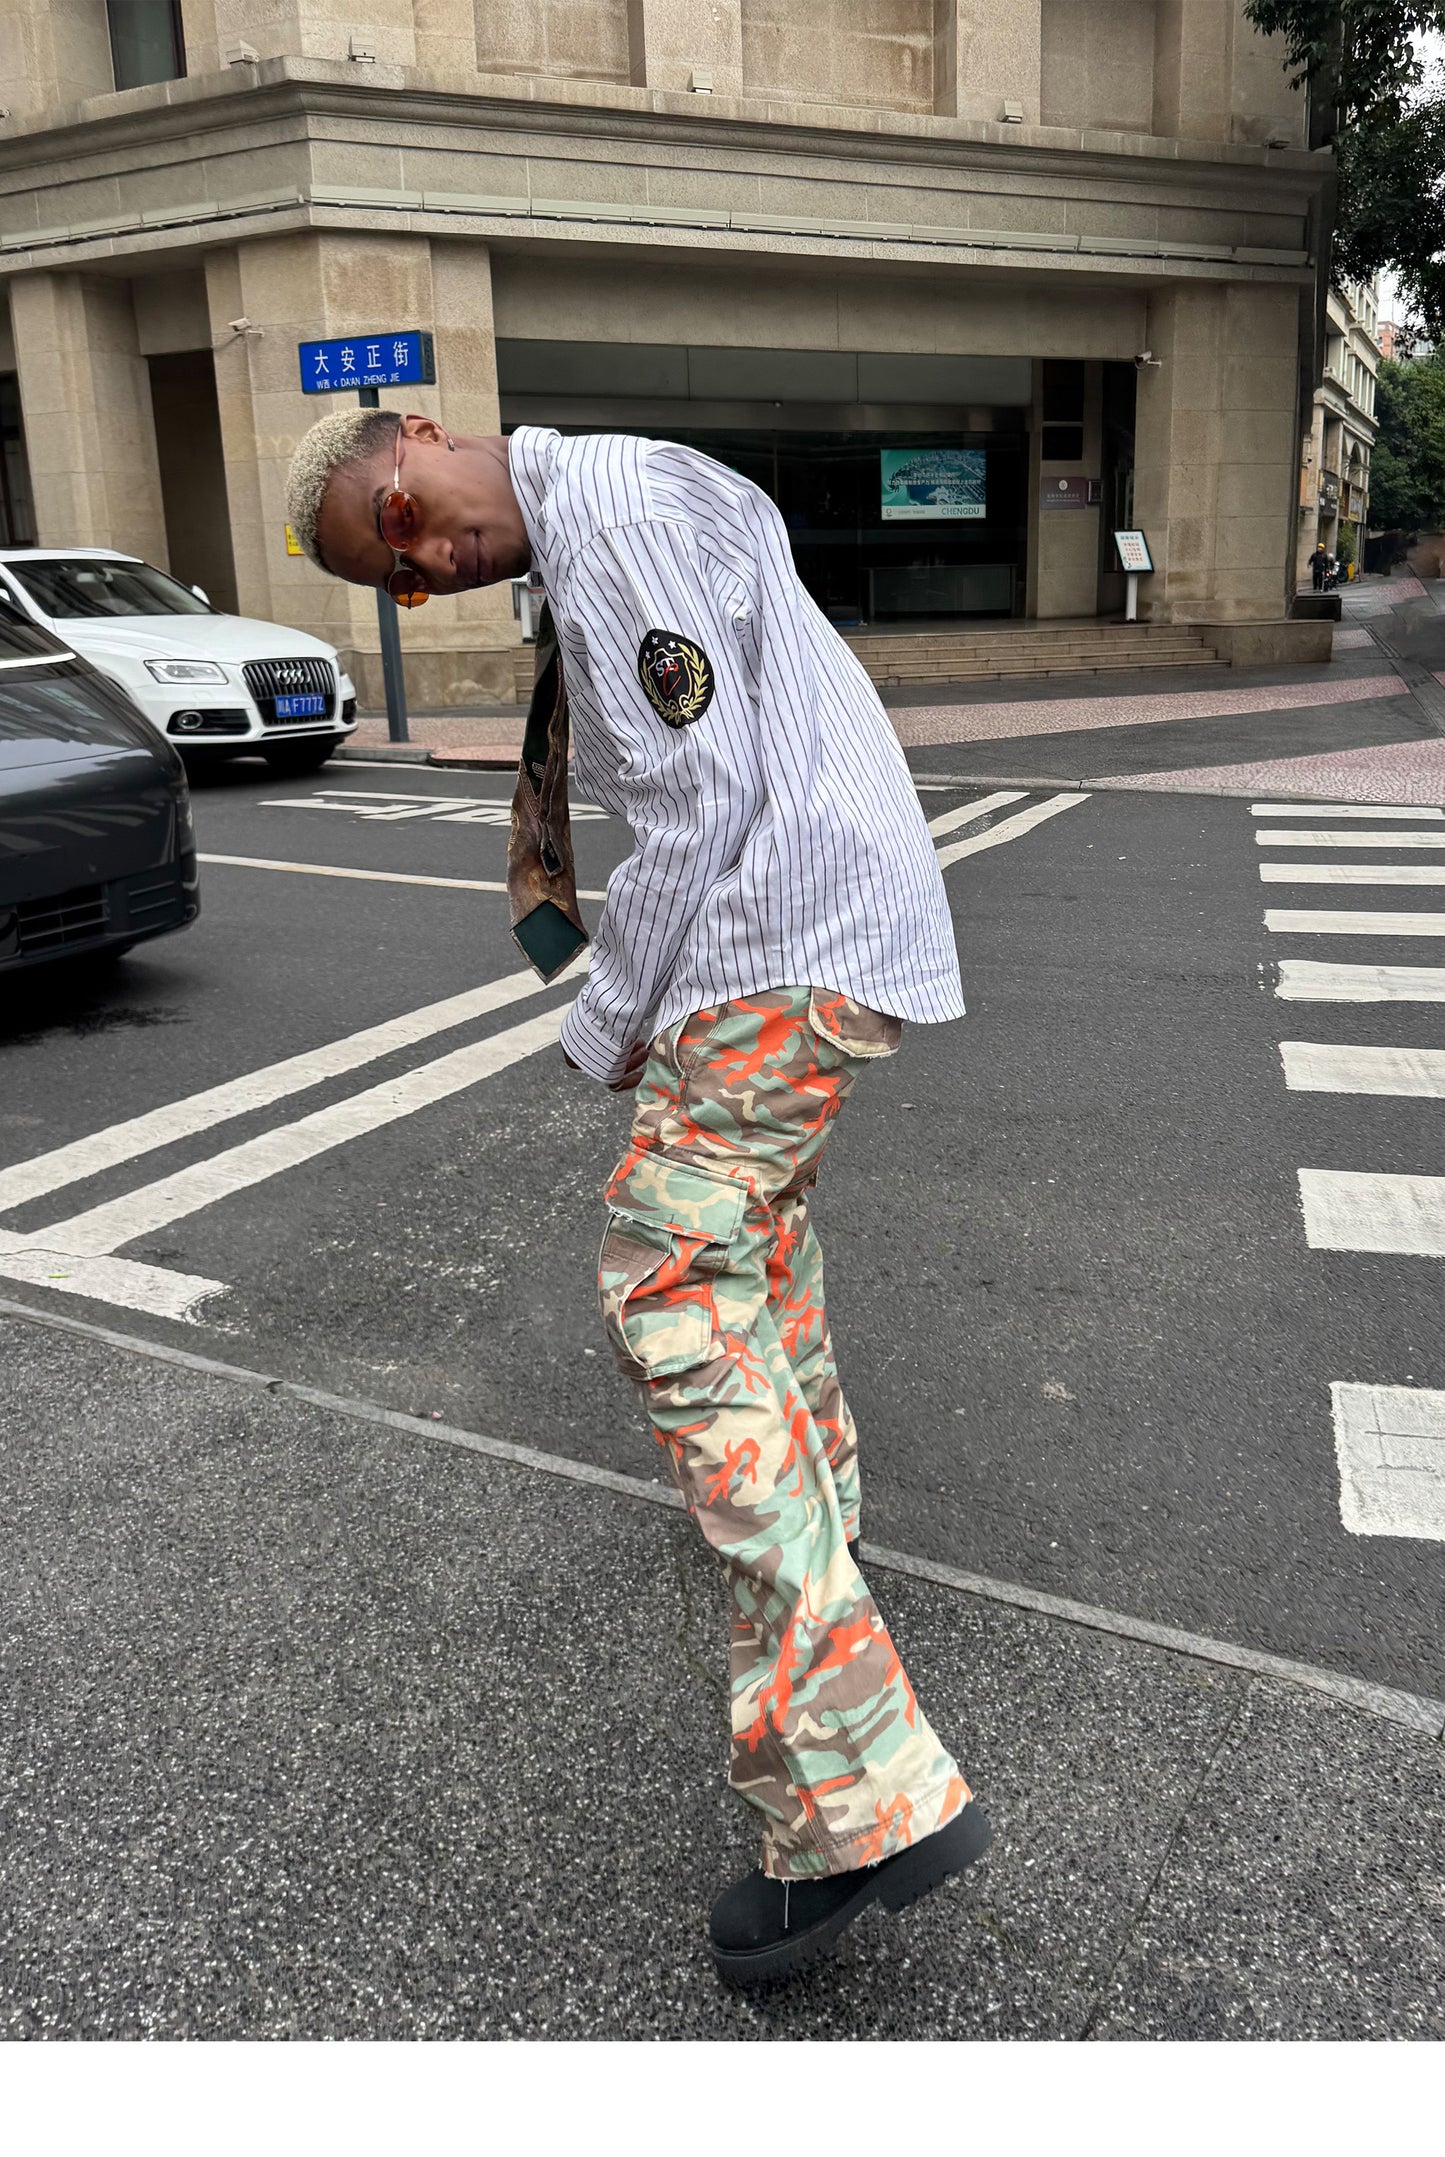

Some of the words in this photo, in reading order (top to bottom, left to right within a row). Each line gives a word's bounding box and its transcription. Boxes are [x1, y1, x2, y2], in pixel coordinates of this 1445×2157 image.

[314, 341, 409, 375] 大安正街
[363, 373, 387, 386] ZHENG
[389, 372, 401, 383] JIE
[941, 507, 980, 516] CHENGDU
